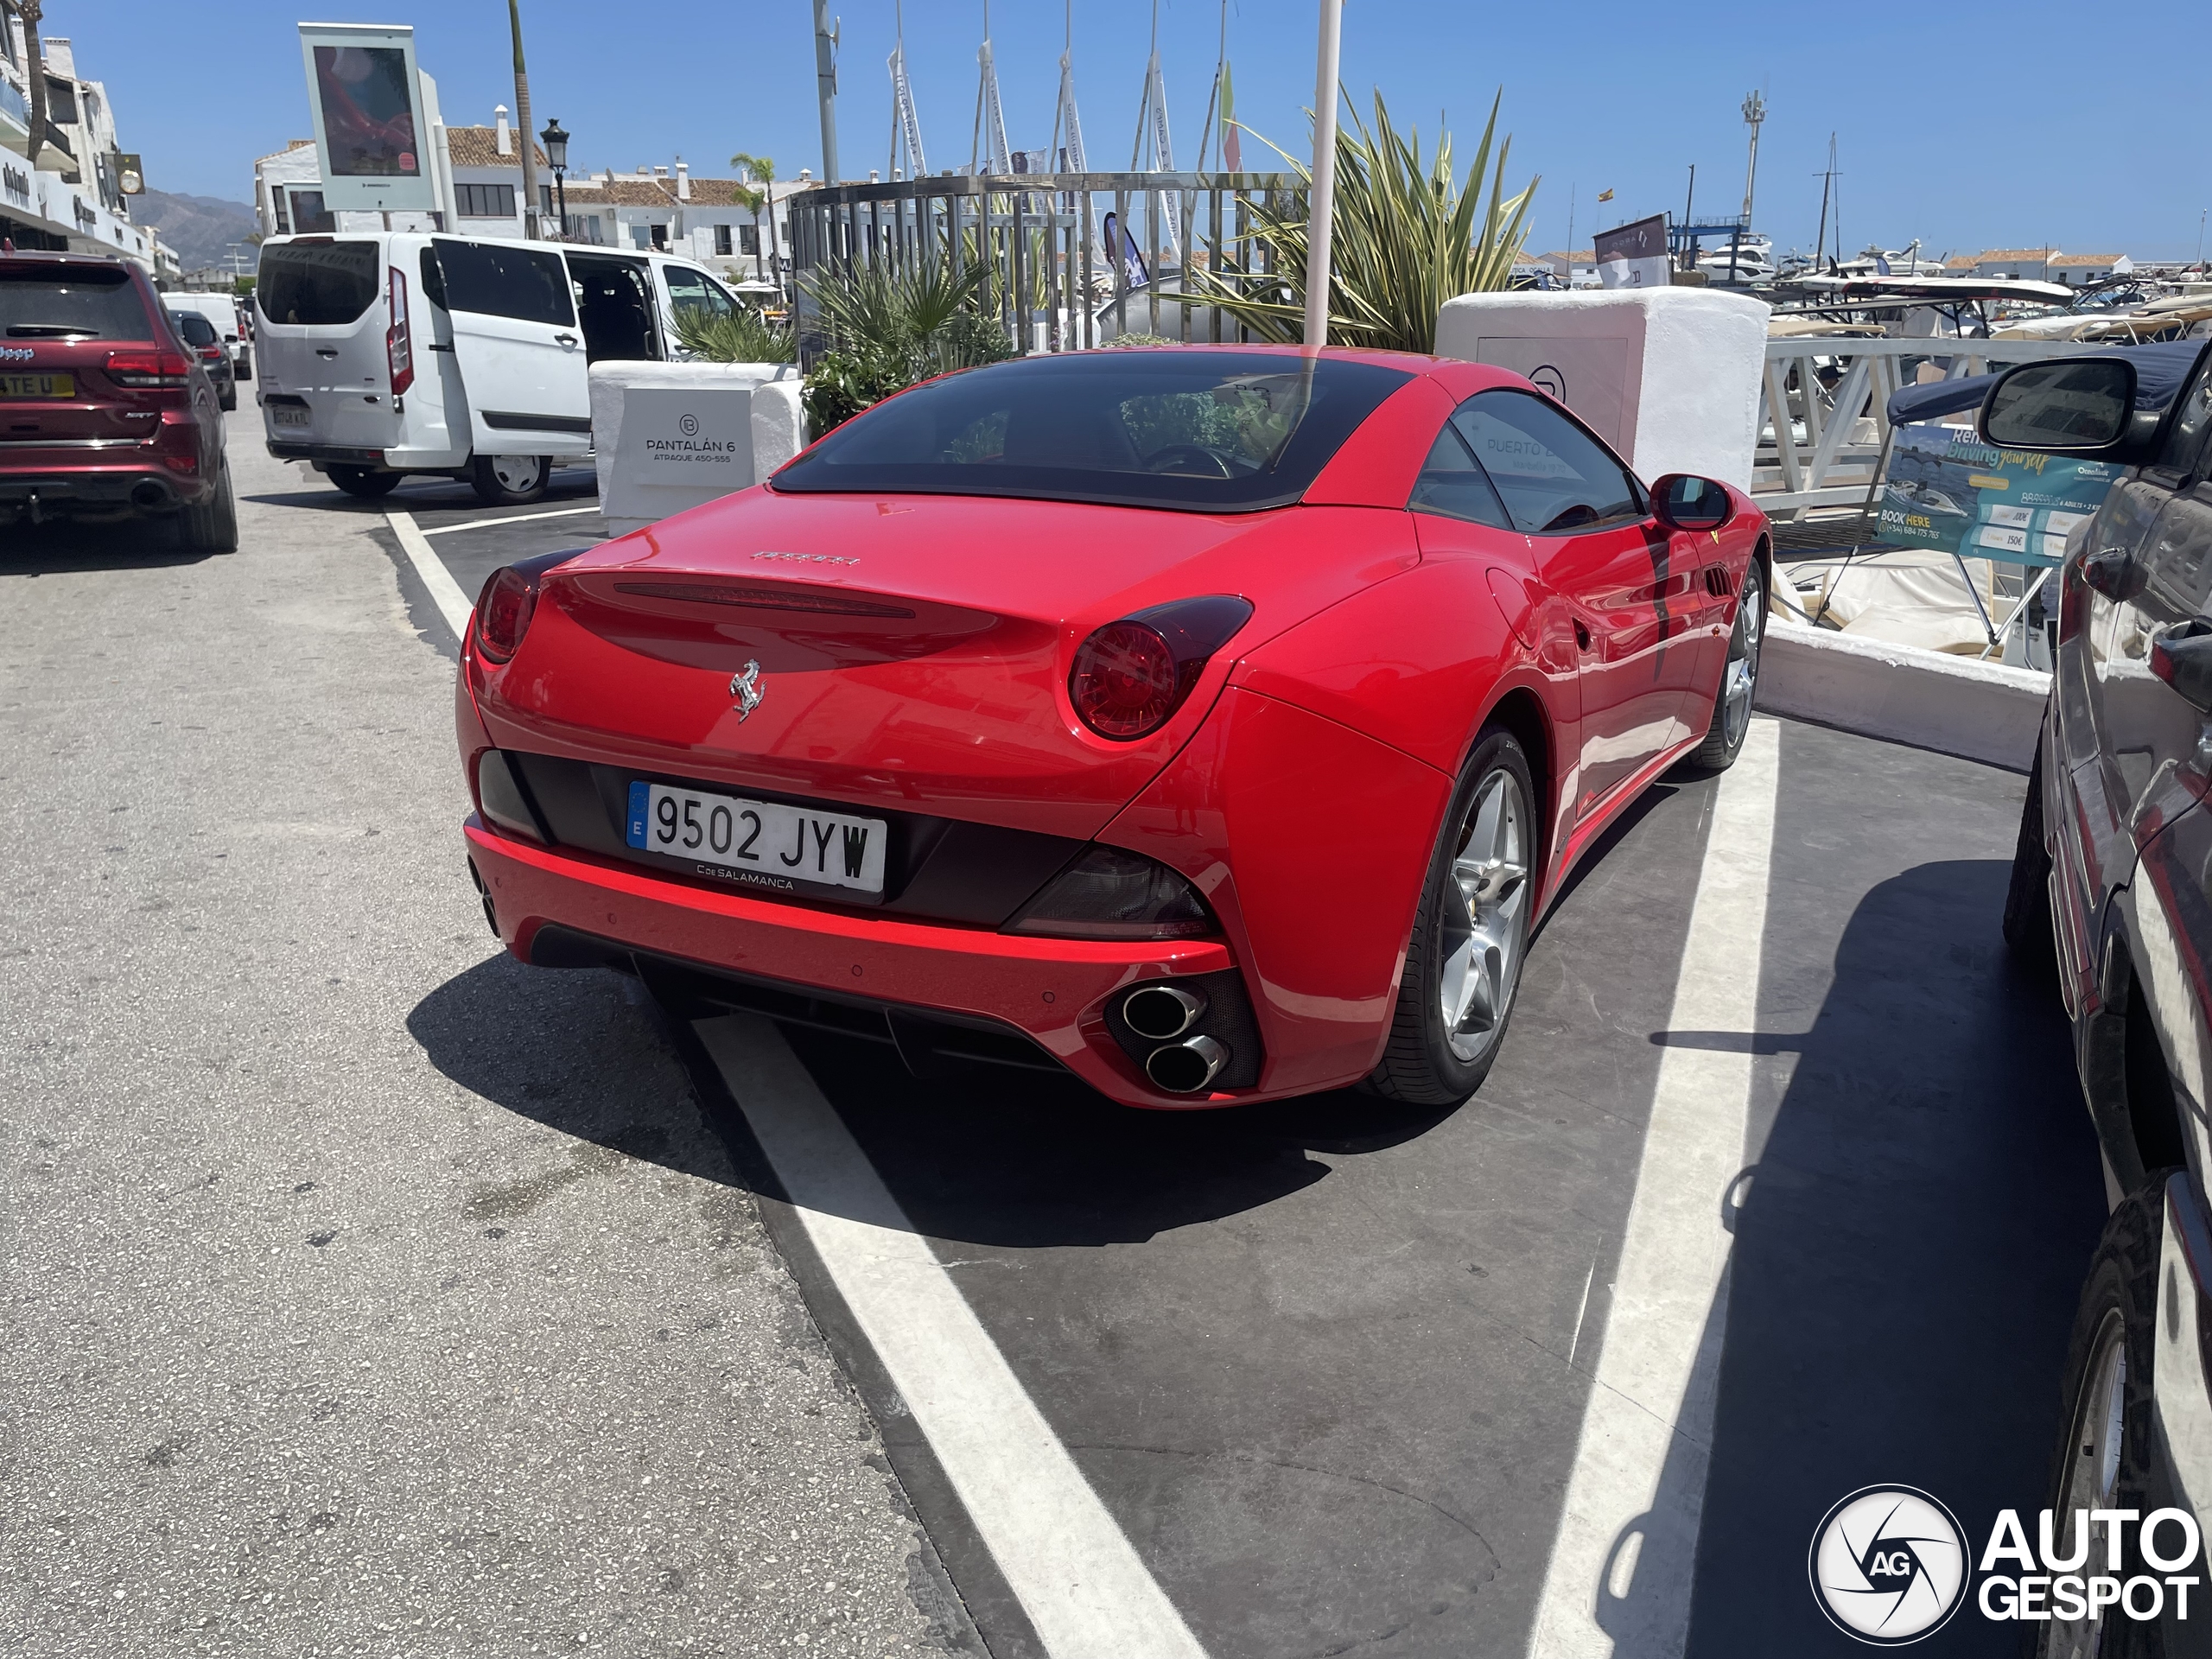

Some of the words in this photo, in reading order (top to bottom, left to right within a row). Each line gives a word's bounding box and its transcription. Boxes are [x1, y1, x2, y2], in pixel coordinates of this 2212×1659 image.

[646, 437, 722, 452] PANTALÁN
[726, 442, 736, 452] 6
[1953, 429, 1986, 445] Ren
[1488, 439, 1541, 455] PUERTO
[1947, 442, 2000, 467] Driving
[695, 454, 731, 463] 450-555
[1881, 509, 1906, 524] BOOK
[1906, 514, 1931, 528] HERE
[1904, 526, 1916, 536] 684
[2006, 535, 2024, 545] 150€
[632, 821, 642, 836] E
[657, 796, 762, 861] 9502
[779, 817, 868, 878] JYW
[717, 868, 794, 890] SALAMANCA
